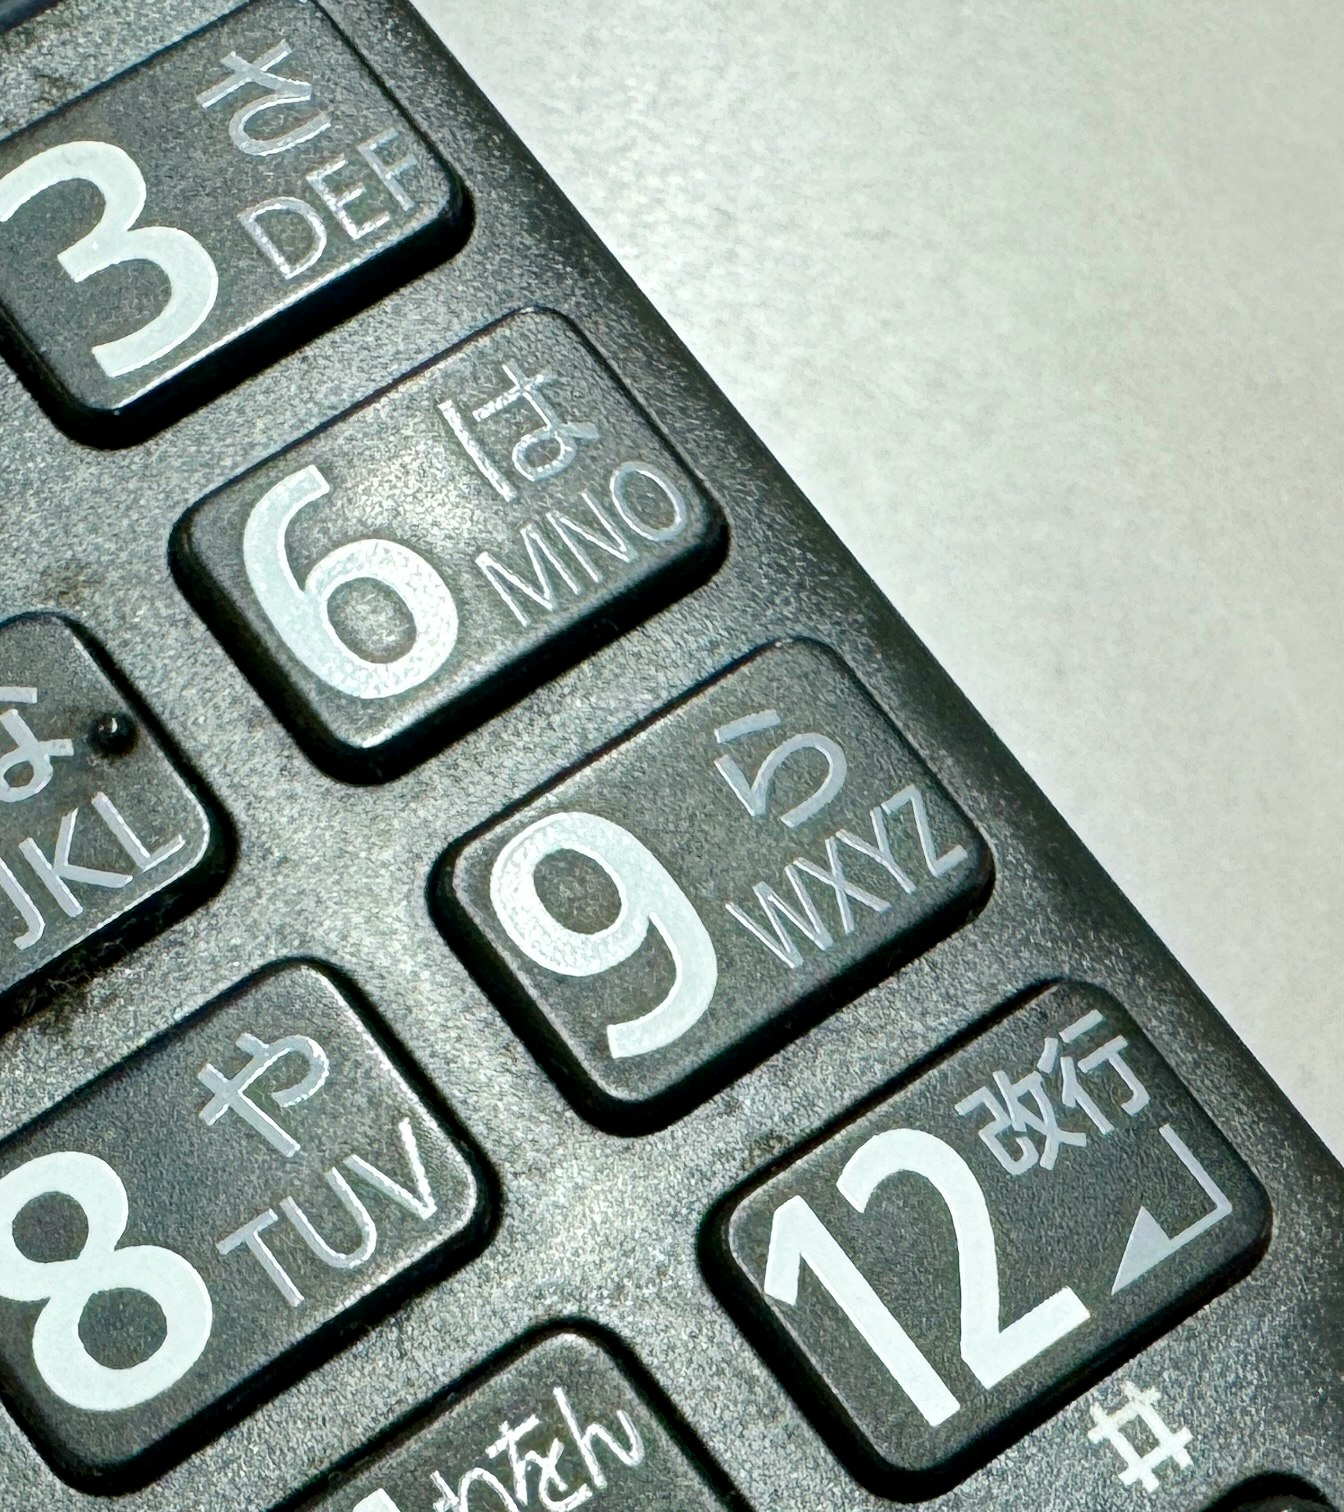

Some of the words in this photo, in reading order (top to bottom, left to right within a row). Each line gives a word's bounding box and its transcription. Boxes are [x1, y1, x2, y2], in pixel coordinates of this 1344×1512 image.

[198, 38, 334, 156] さ
[241, 129, 422, 280] DEF
[438, 363, 599, 502] は
[243, 464, 459, 700] 6
[476, 460, 690, 627] MNO
[714, 709, 849, 828] ら
[488, 811, 718, 1059] 9
[725, 784, 969, 968] WXYZ
[196, 1032, 330, 1158] や
[953, 1009, 1151, 1178] 改行
[216, 1118, 438, 1308] TUV
[763, 1127, 1091, 1427] 12
